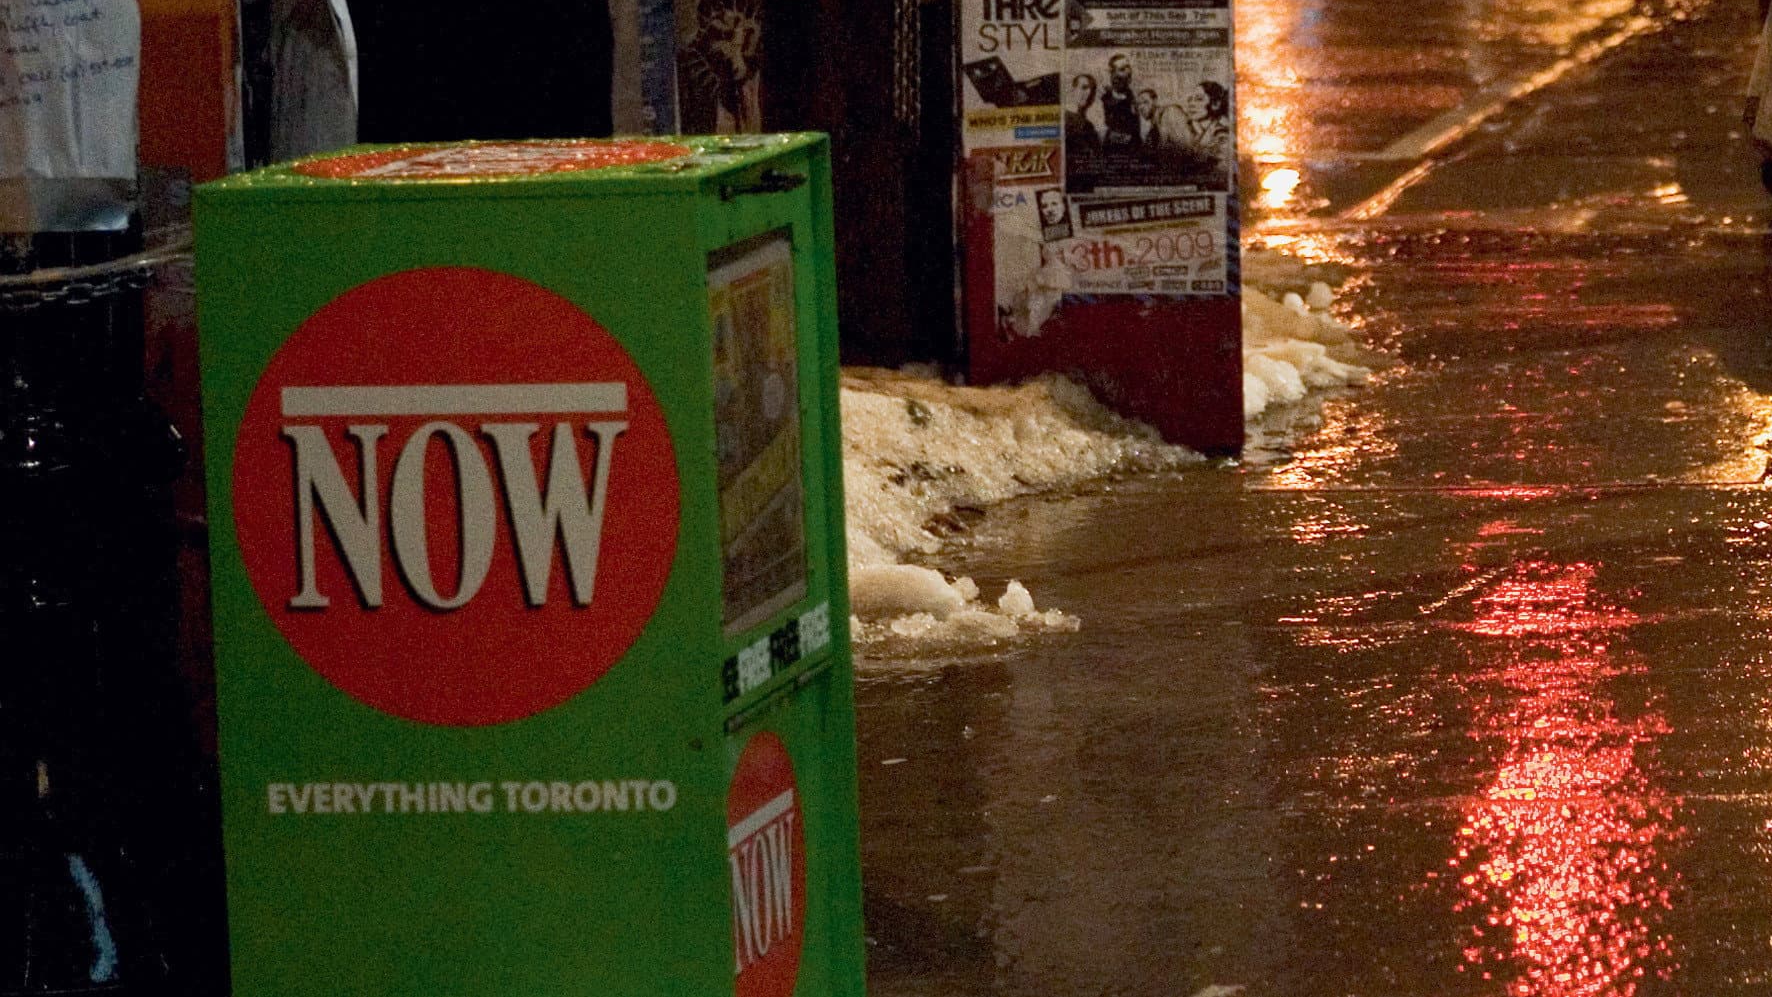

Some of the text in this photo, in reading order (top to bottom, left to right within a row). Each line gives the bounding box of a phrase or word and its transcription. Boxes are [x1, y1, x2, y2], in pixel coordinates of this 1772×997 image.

[977, 22, 1061, 53] STYL
[1173, 197, 1212, 215] SCENE
[282, 419, 629, 612] NOW
[268, 780, 677, 814] EVERYTHING TORONTO
[728, 811, 796, 976] NOW
